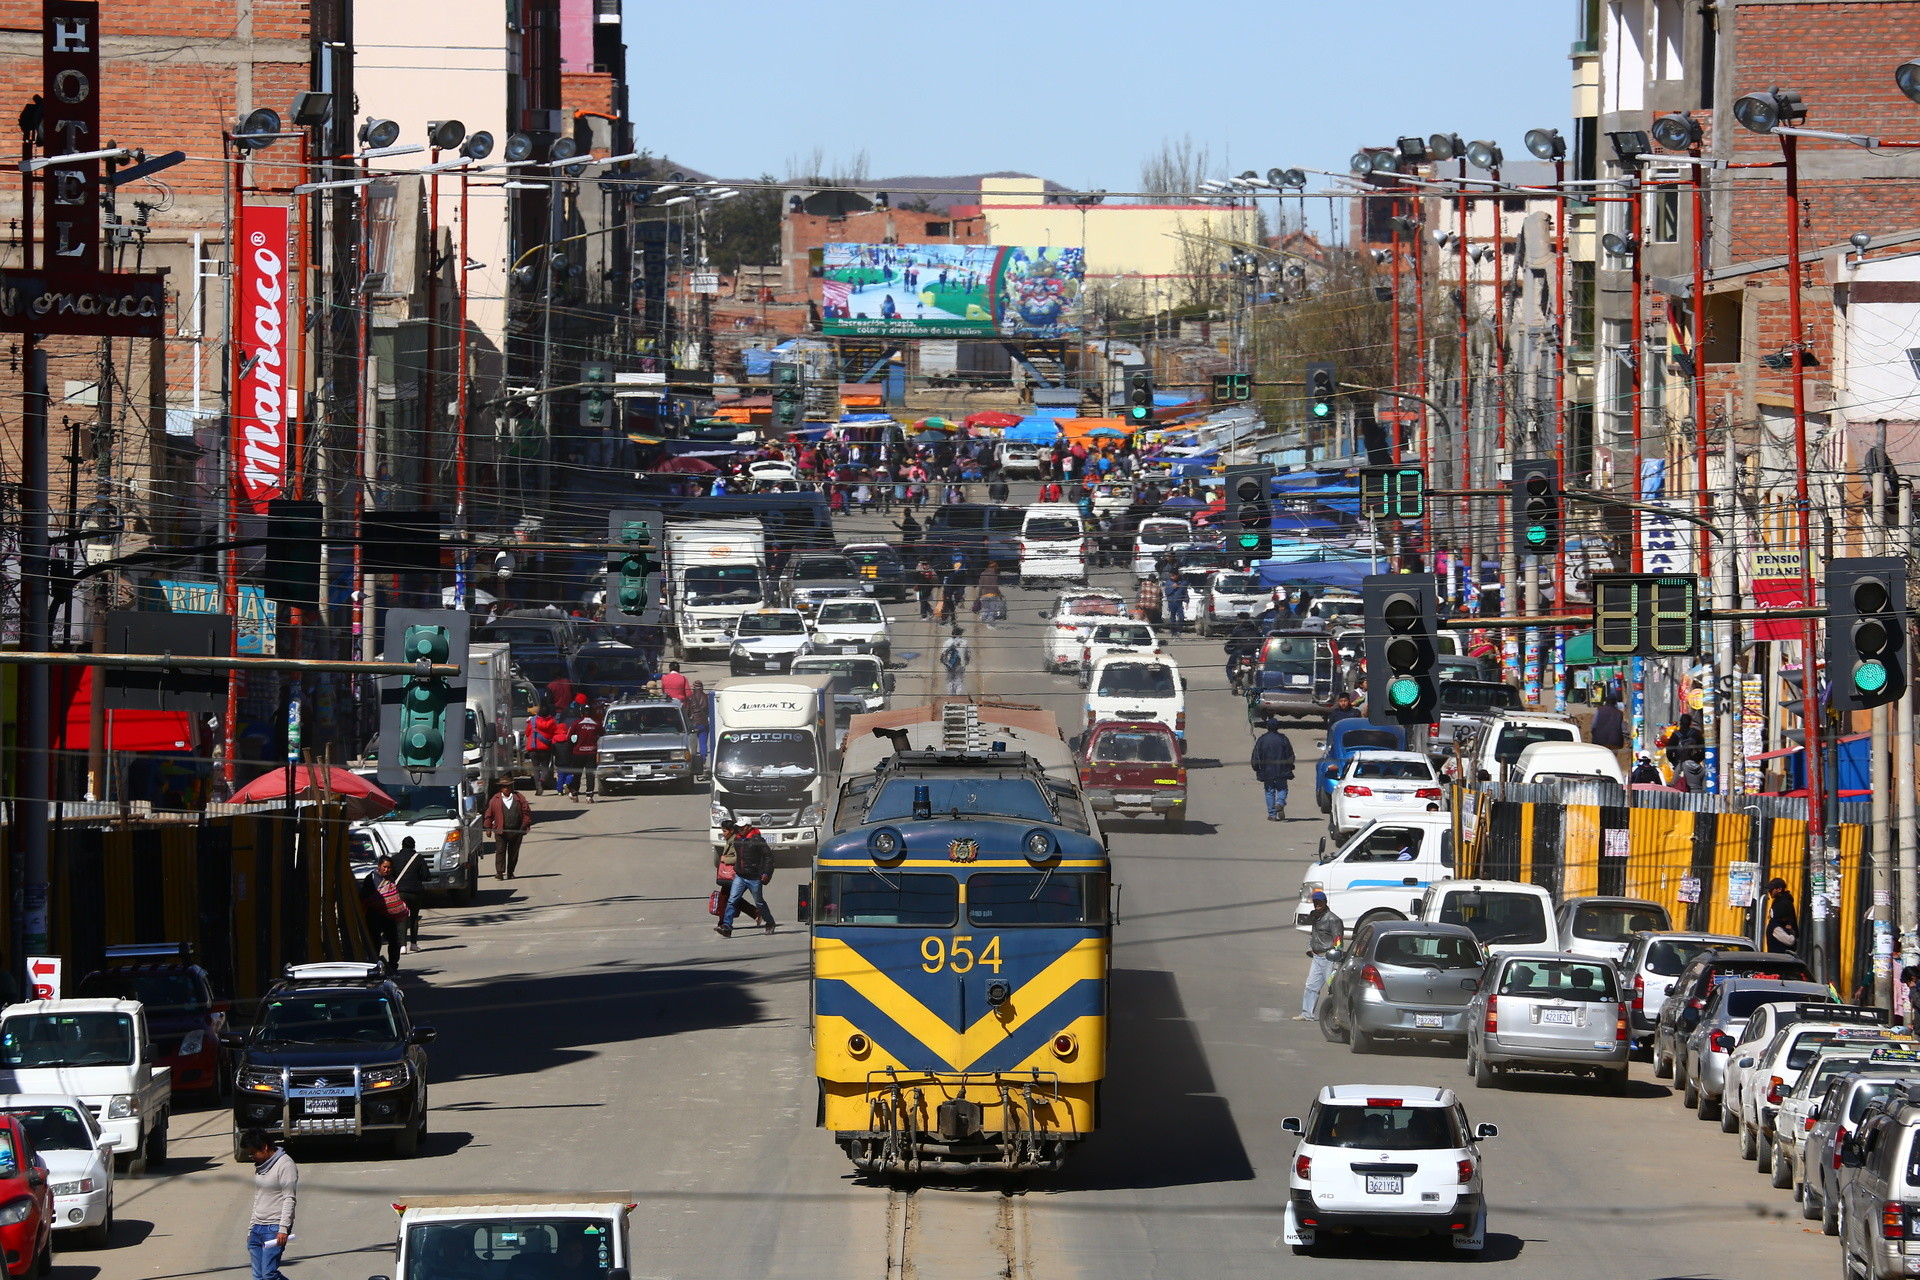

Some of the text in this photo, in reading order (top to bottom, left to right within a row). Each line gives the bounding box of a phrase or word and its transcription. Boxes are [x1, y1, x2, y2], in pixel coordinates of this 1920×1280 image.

[52, 17, 91, 257] HOTEL
[1383, 470, 1423, 517] 10
[1756, 555, 1800, 564] PENSIO
[1757, 567, 1801, 577] JUANE
[781, 702, 797, 710] TX
[740, 733, 793, 741] FOTON
[921, 936, 1002, 974] 954
[1369, 1180, 1400, 1191] 3621YEA
